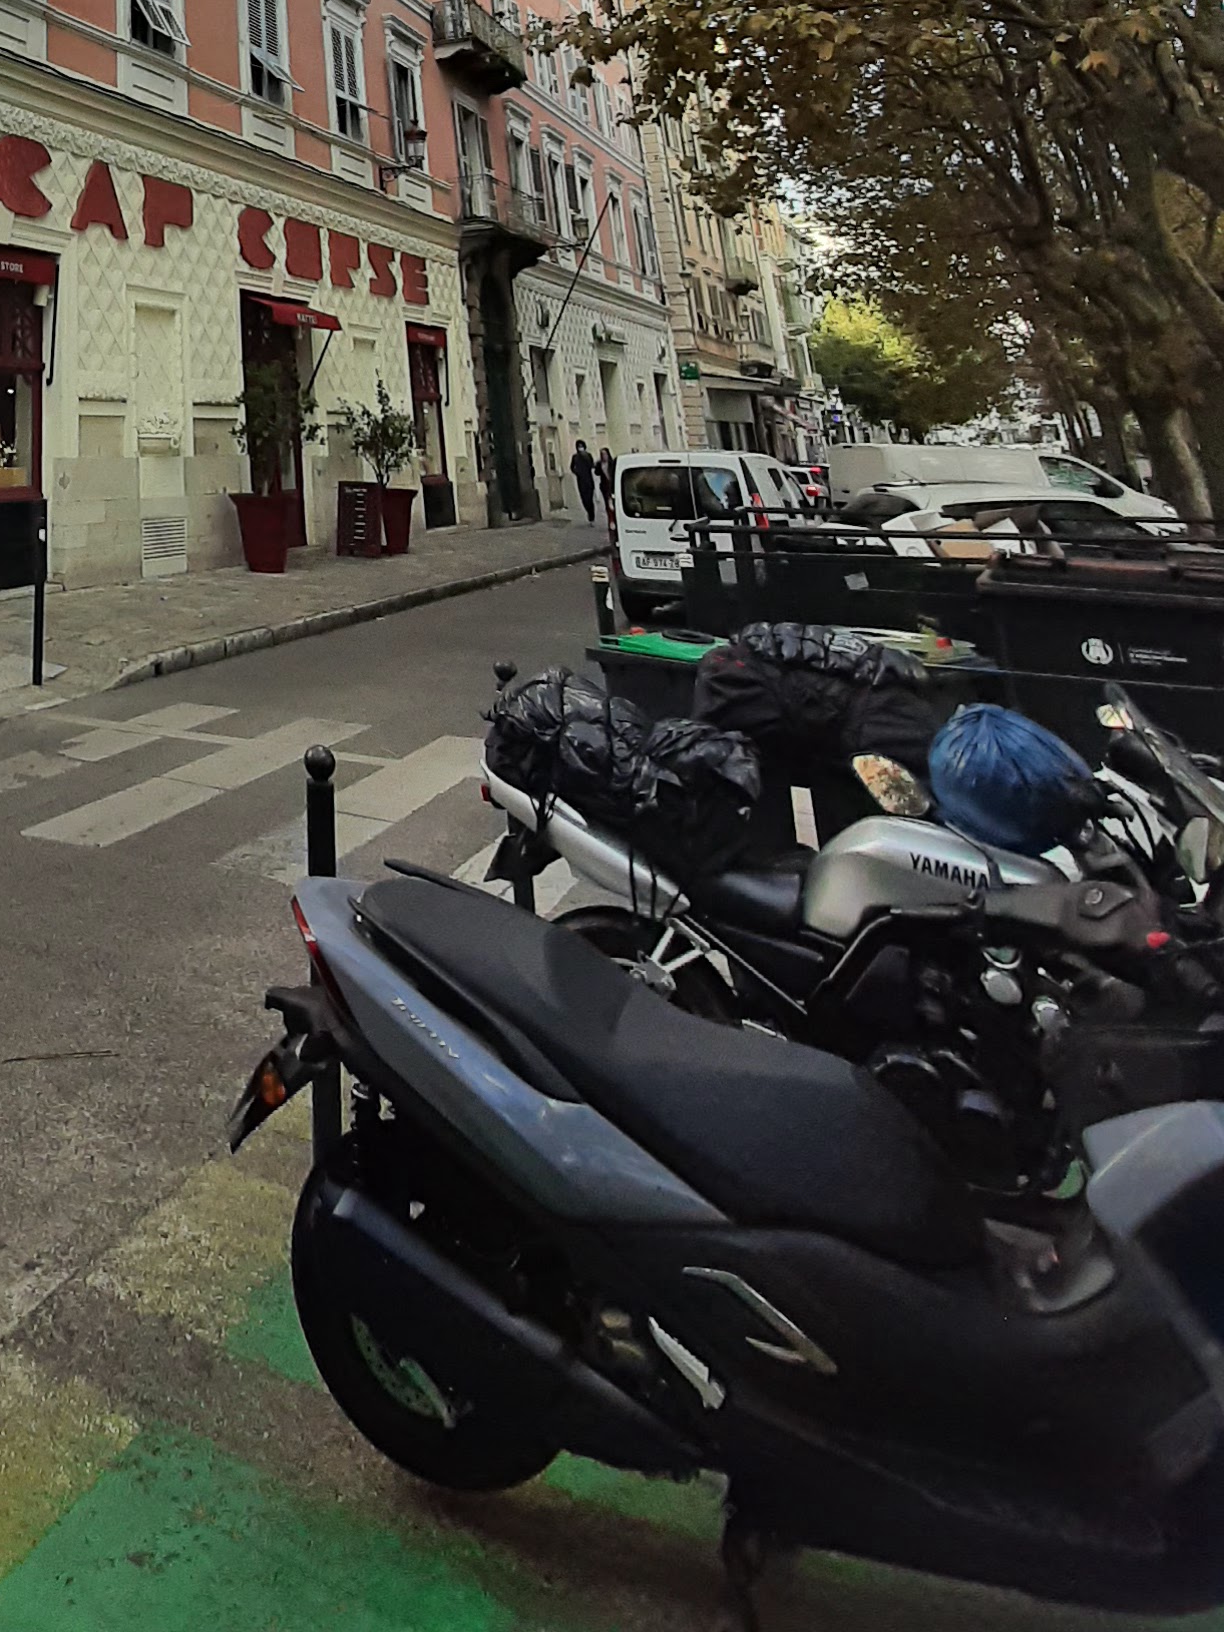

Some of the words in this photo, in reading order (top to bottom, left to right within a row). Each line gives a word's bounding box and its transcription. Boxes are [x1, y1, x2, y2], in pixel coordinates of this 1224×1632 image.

[0, 260, 24, 274] STORE
[237, 205, 430, 305] CORSE
[909, 851, 990, 891] YAMAHA
